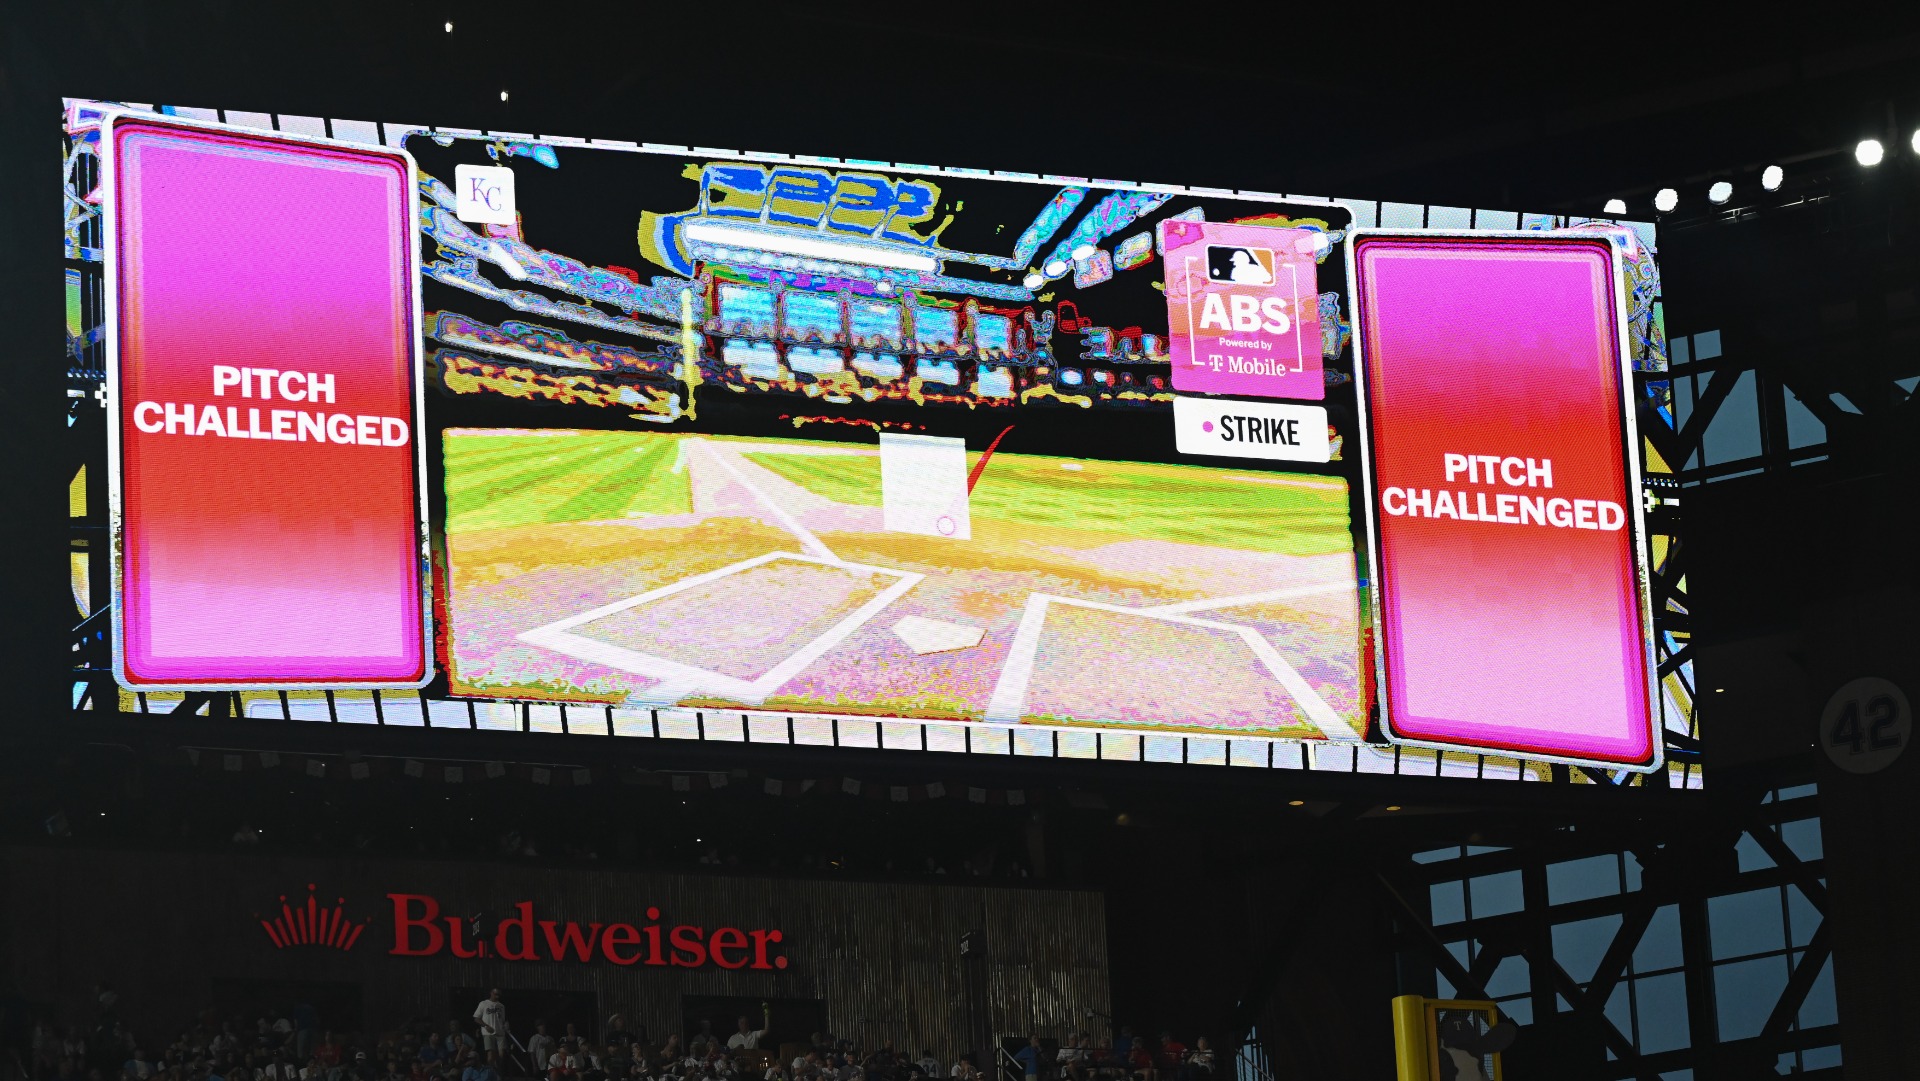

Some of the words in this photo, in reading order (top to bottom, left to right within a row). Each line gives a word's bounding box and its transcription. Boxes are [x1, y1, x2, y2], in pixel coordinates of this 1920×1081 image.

[469, 177, 502, 211] KC
[1200, 293, 1291, 334] ABS
[1219, 337, 1260, 348] Powered
[1261, 341, 1273, 351] by
[1228, 355, 1286, 377] Mobile
[213, 365, 336, 403] PITCH
[133, 401, 409, 447] CHALLENGED
[1220, 414, 1300, 446] STRIKE
[1444, 453, 1553, 488] PITCH
[1382, 486, 1625, 531] CHALLENGED
[1831, 694, 1902, 755] 42
[1453, 1020, 1462, 1031] T
